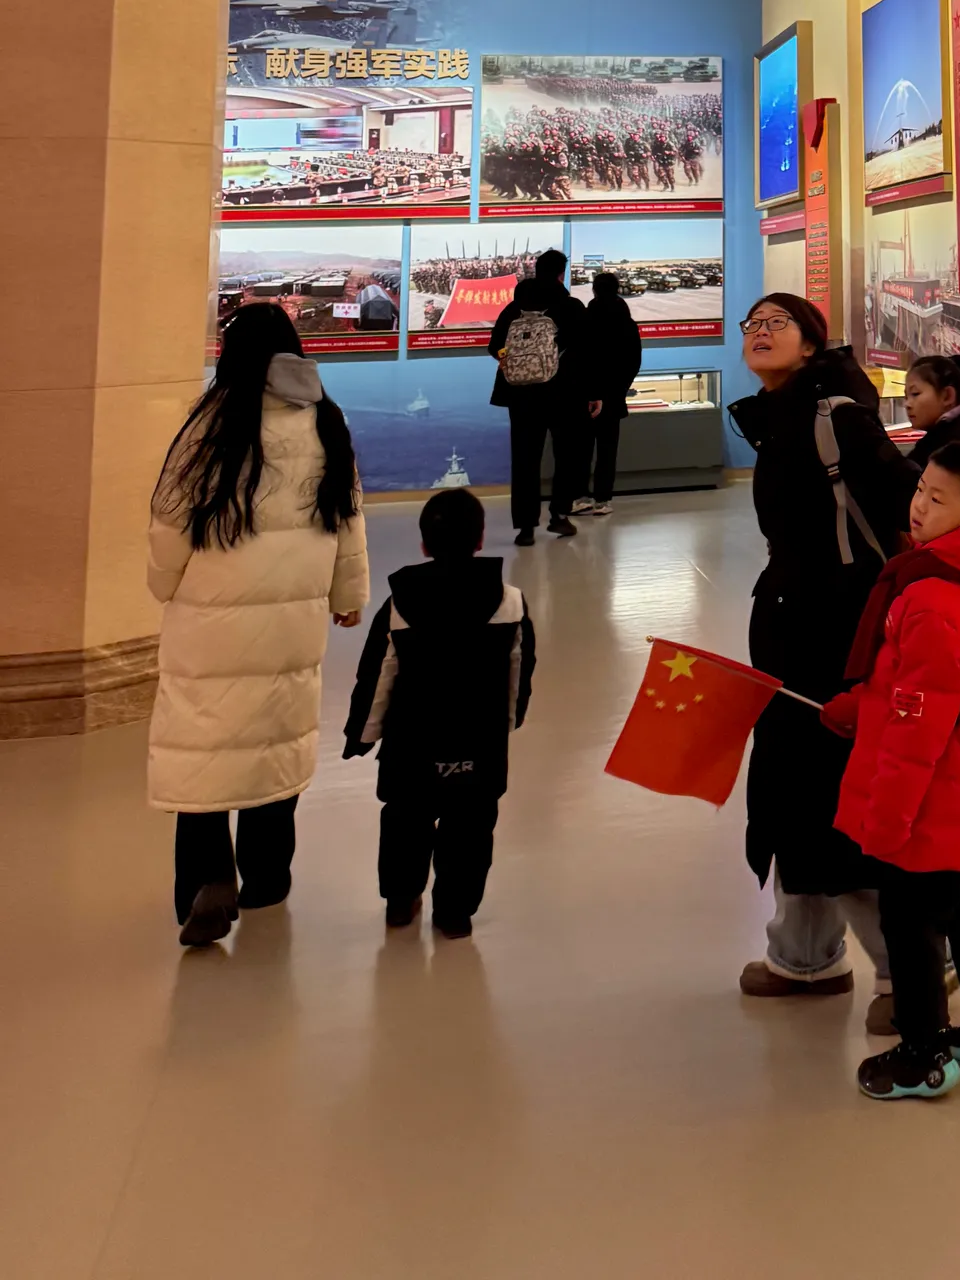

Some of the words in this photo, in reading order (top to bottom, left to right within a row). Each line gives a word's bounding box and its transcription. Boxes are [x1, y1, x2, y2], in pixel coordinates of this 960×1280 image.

[265, 48, 470, 80] 献身强军实践
